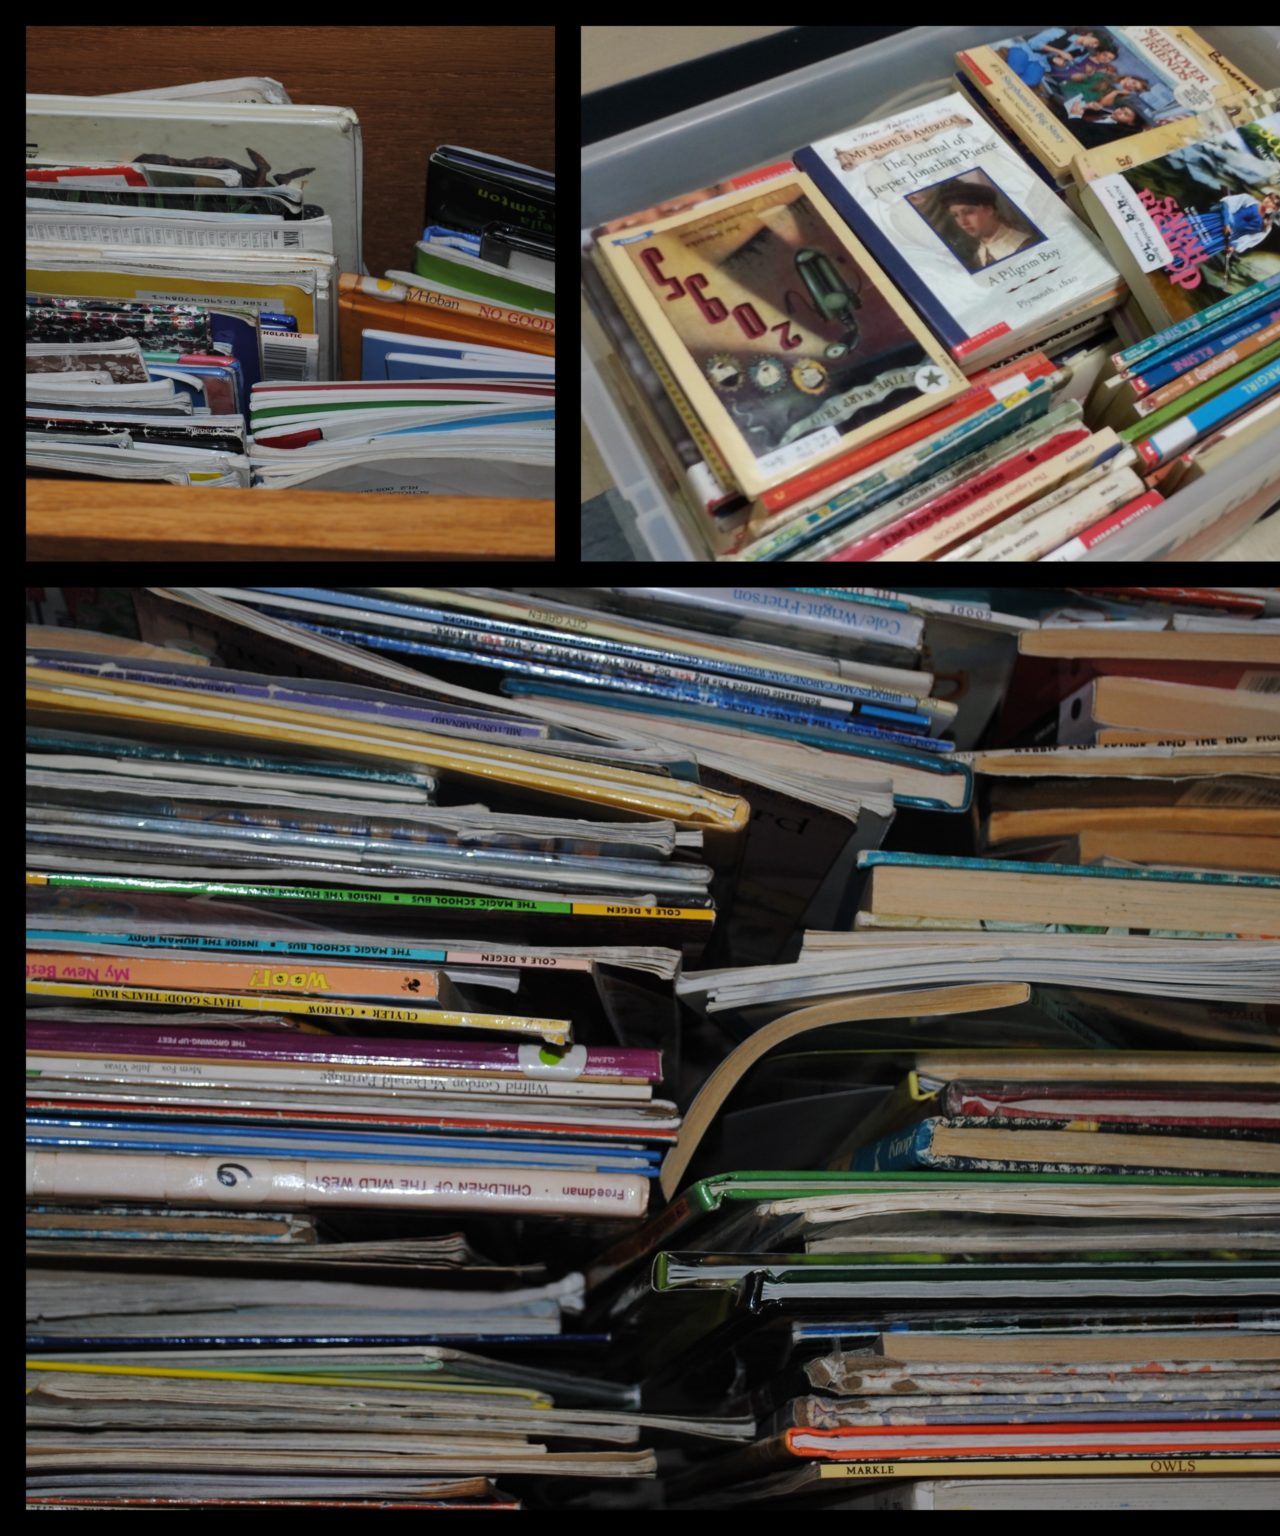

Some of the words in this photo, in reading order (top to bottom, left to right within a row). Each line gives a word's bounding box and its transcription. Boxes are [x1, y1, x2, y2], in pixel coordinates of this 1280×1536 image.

[1138, 33, 1190, 83] FRIENDS
[1144, 26, 1208, 85] SLEEPOVER
[882, 155, 907, 172] The
[907, 139, 952, 166] Journal
[951, 132, 966, 147] of
[866, 172, 908, 200] Jasper
[908, 153, 963, 184] Jonathan
[962, 138, 999, 159] Pierce
[1154, 191, 1211, 268] SARAH
[1122, 184, 1205, 298] BISHOP
[987, 274, 1000, 287] A
[999, 257, 1040, 282] Pilgrim
[1039, 246, 1061, 264] Boy
[478, 305, 502, 320] NO
[507, 312, 555, 332] GOOD
[872, 373, 906, 393] TIME
[841, 386, 875, 410] WARP
[1062, 441, 1096, 466] Gregory
[935, 473, 950, 486] TO
[1026, 470, 1048, 488] The
[1001, 480, 1029, 502] Legend
[526, 608, 562, 625] GREEN
[731, 587, 901, 636] Cole/Wright-Frierson
[563, 616, 588, 630] CITY
[278, 887, 320, 898] HUMAN
[322, 890, 343, 899] THE
[345, 892, 381, 902] INSIDE
[410, 894, 431, 903] BUS
[434, 896, 475, 906] SCHOOL
[478, 898, 509, 907] MAGIC
[511, 900, 536, 909] THE
[606, 905, 641, 914] DEGEN
[644, 907, 651, 915] &
[654, 907, 680, 916] COLE
[127, 933, 156, 942] BODY
[159, 935, 199, 944] HUMAN
[202, 937, 222, 945] THE
[224, 938, 258, 947] INSIDE
[287, 941, 306, 951] BUS
[309, 942, 350, 953] SCHOOL
[354, 945, 388, 954] MAGIC
[391, 947, 410, 956] THE
[480, 953, 515, 963] DEGEN
[520, 955, 527, 964] &
[529, 956, 556, 965] COLE
[62, 964, 98, 982] New
[105, 964, 129, 981] My
[91, 988, 118, 999] BAD!
[121, 989, 159, 1002] THAT'S
[163, 992, 199, 1004] GOOD!
[200, 994, 240, 1007] THAT'S
[306, 1004, 354, 1016] CATROW
[372, 1008, 418, 1021] CUYLER
[177, 1036, 229, 1046] GROWING-UP
[230, 1039, 246, 1047] THE
[103, 1062, 128, 1072] Vivas
[130, 1063, 150, 1072] Julie
[160, 1064, 176, 1073] Fox
[179, 1065, 201, 1074] Mem
[451, 1077, 500, 1092] Gordon
[504, 1080, 548, 1095] Wilfrid
[313, 1175, 353, 1188] WEST
[358, 1177, 394, 1189] WILD
[398, 1178, 427, 1191] THE
[457, 1181, 531, 1196] CHILDREN
[561, 1186, 624, 1201] Freedman
[846, 1465, 894, 1474] MARKLE
[1150, 1460, 1196, 1472] OWLS
